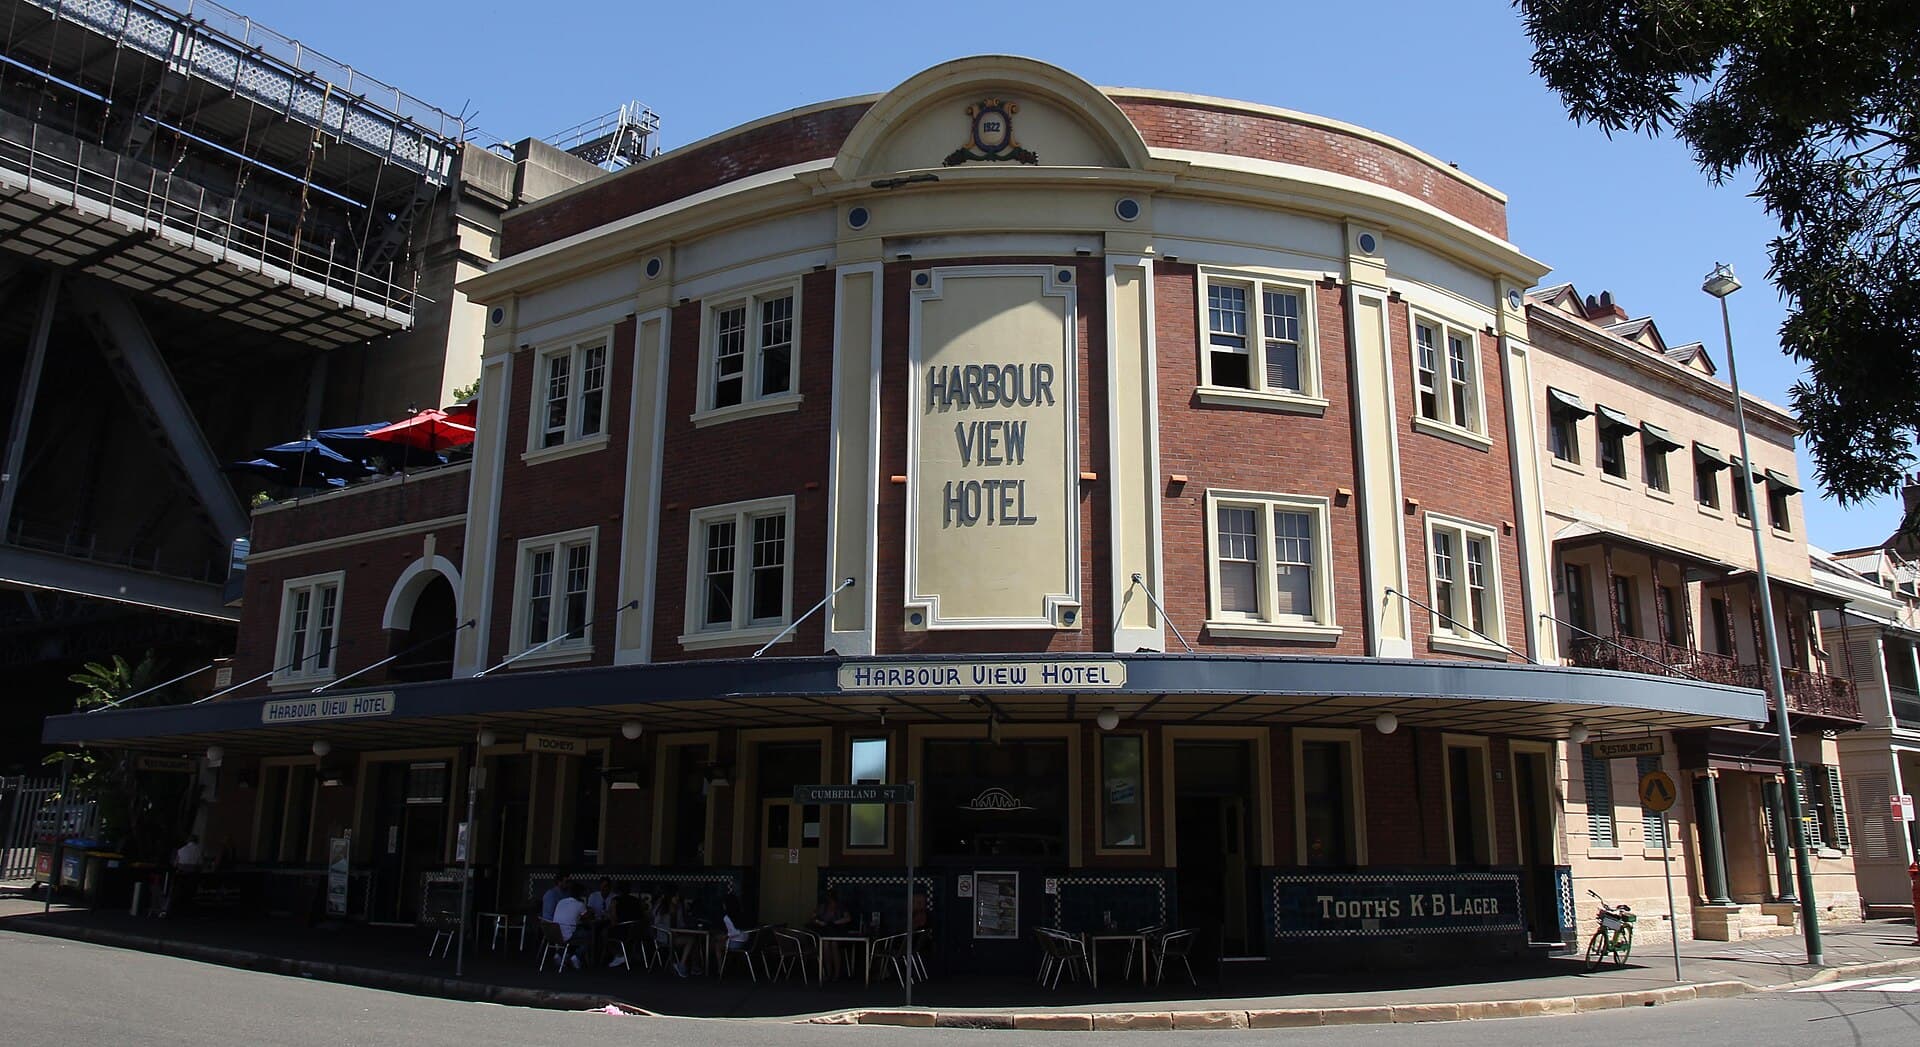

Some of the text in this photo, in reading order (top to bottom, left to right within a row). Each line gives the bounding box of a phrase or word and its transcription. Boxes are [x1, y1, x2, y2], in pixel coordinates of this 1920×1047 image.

[925, 363, 1056, 415] HARBOUR
[954, 420, 1027, 468] VIEW
[942, 479, 1038, 529] HOTEL
[855, 664, 1110, 687] HARBOUR VIEW HOTEL
[269, 697, 386, 720] HARBOUR VIEW HOTEL
[1600, 742, 1655, 756] RESTAURANT
[811, 789, 896, 800] CUMBERLAND ST
[1317, 895, 1401, 919] TOOTH'S
[1449, 893, 1499, 916] LAGER
